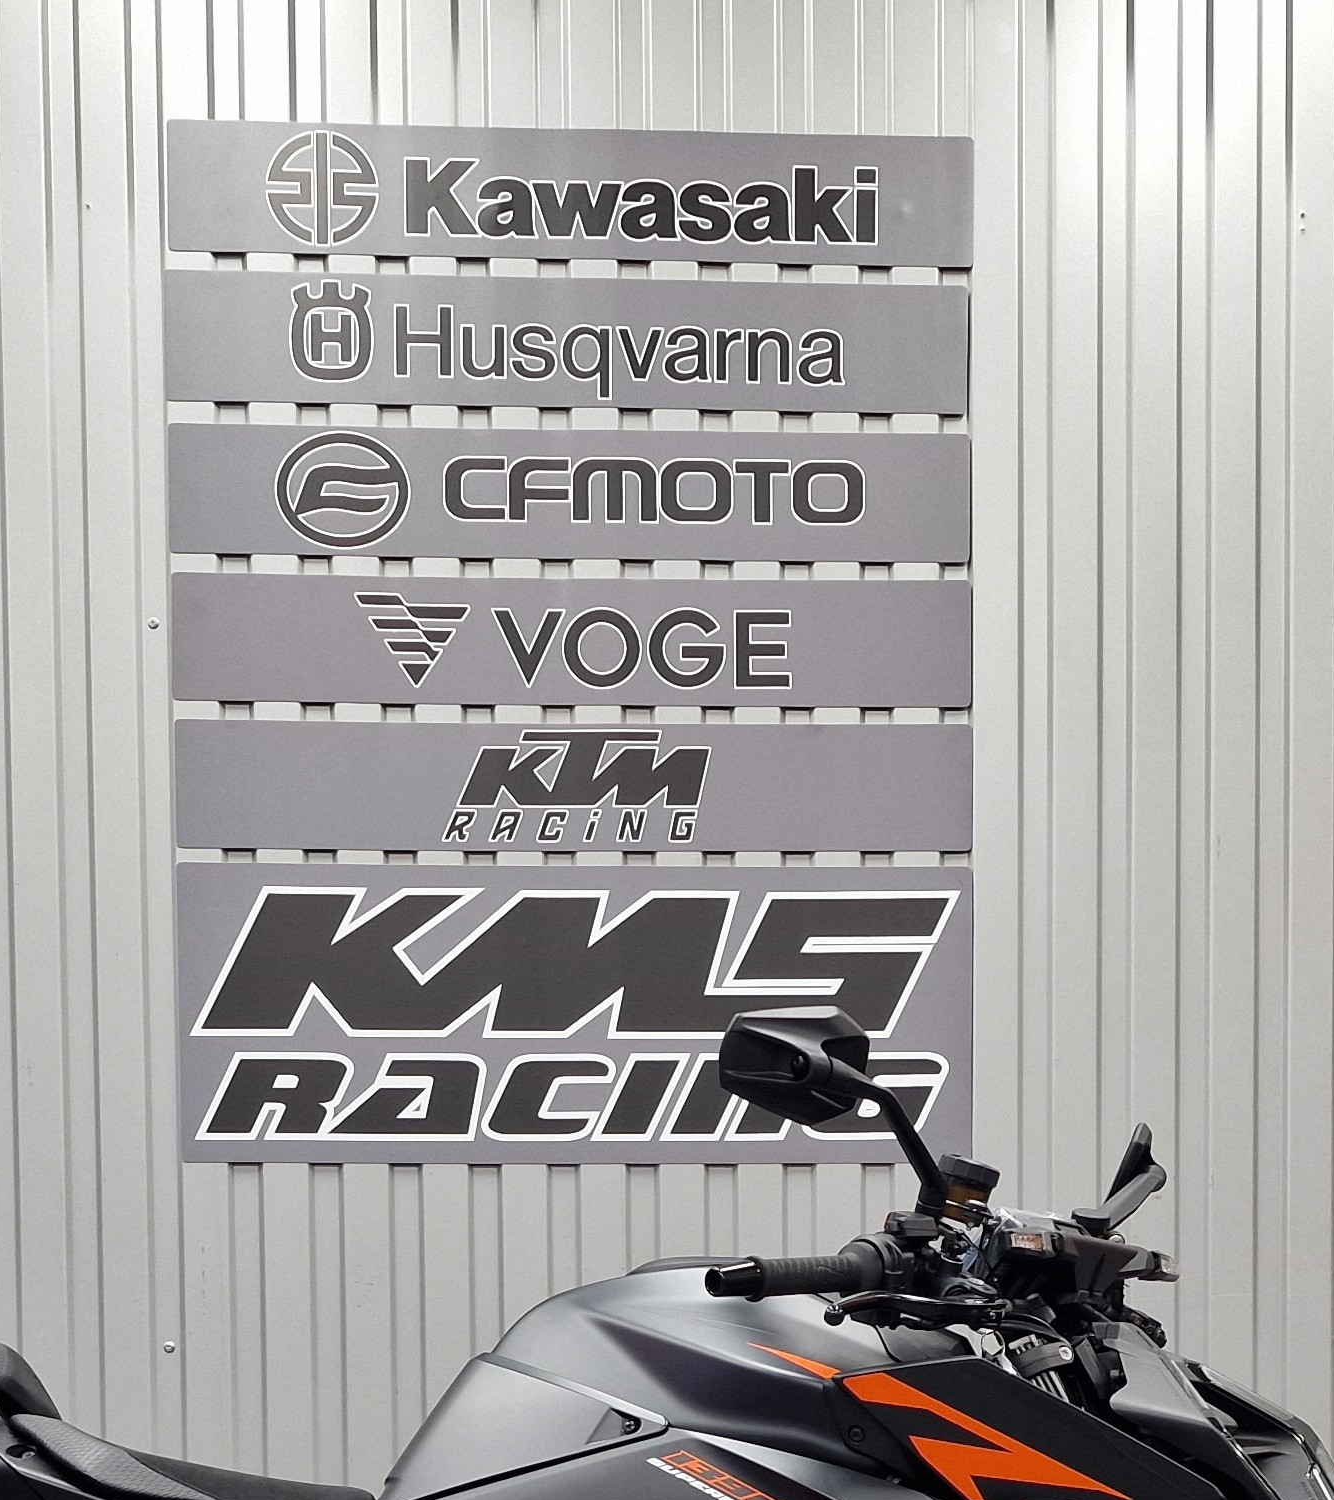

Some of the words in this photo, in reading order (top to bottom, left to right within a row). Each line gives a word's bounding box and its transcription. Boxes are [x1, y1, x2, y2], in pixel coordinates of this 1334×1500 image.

[404, 157, 879, 245] Kawasaki
[393, 304, 846, 400] Husqvarna
[442, 455, 866, 526] CFMOTO
[491, 607, 793, 690] VOGE
[457, 728, 712, 808] KTM
[189, 886, 961, 1039] KMS
